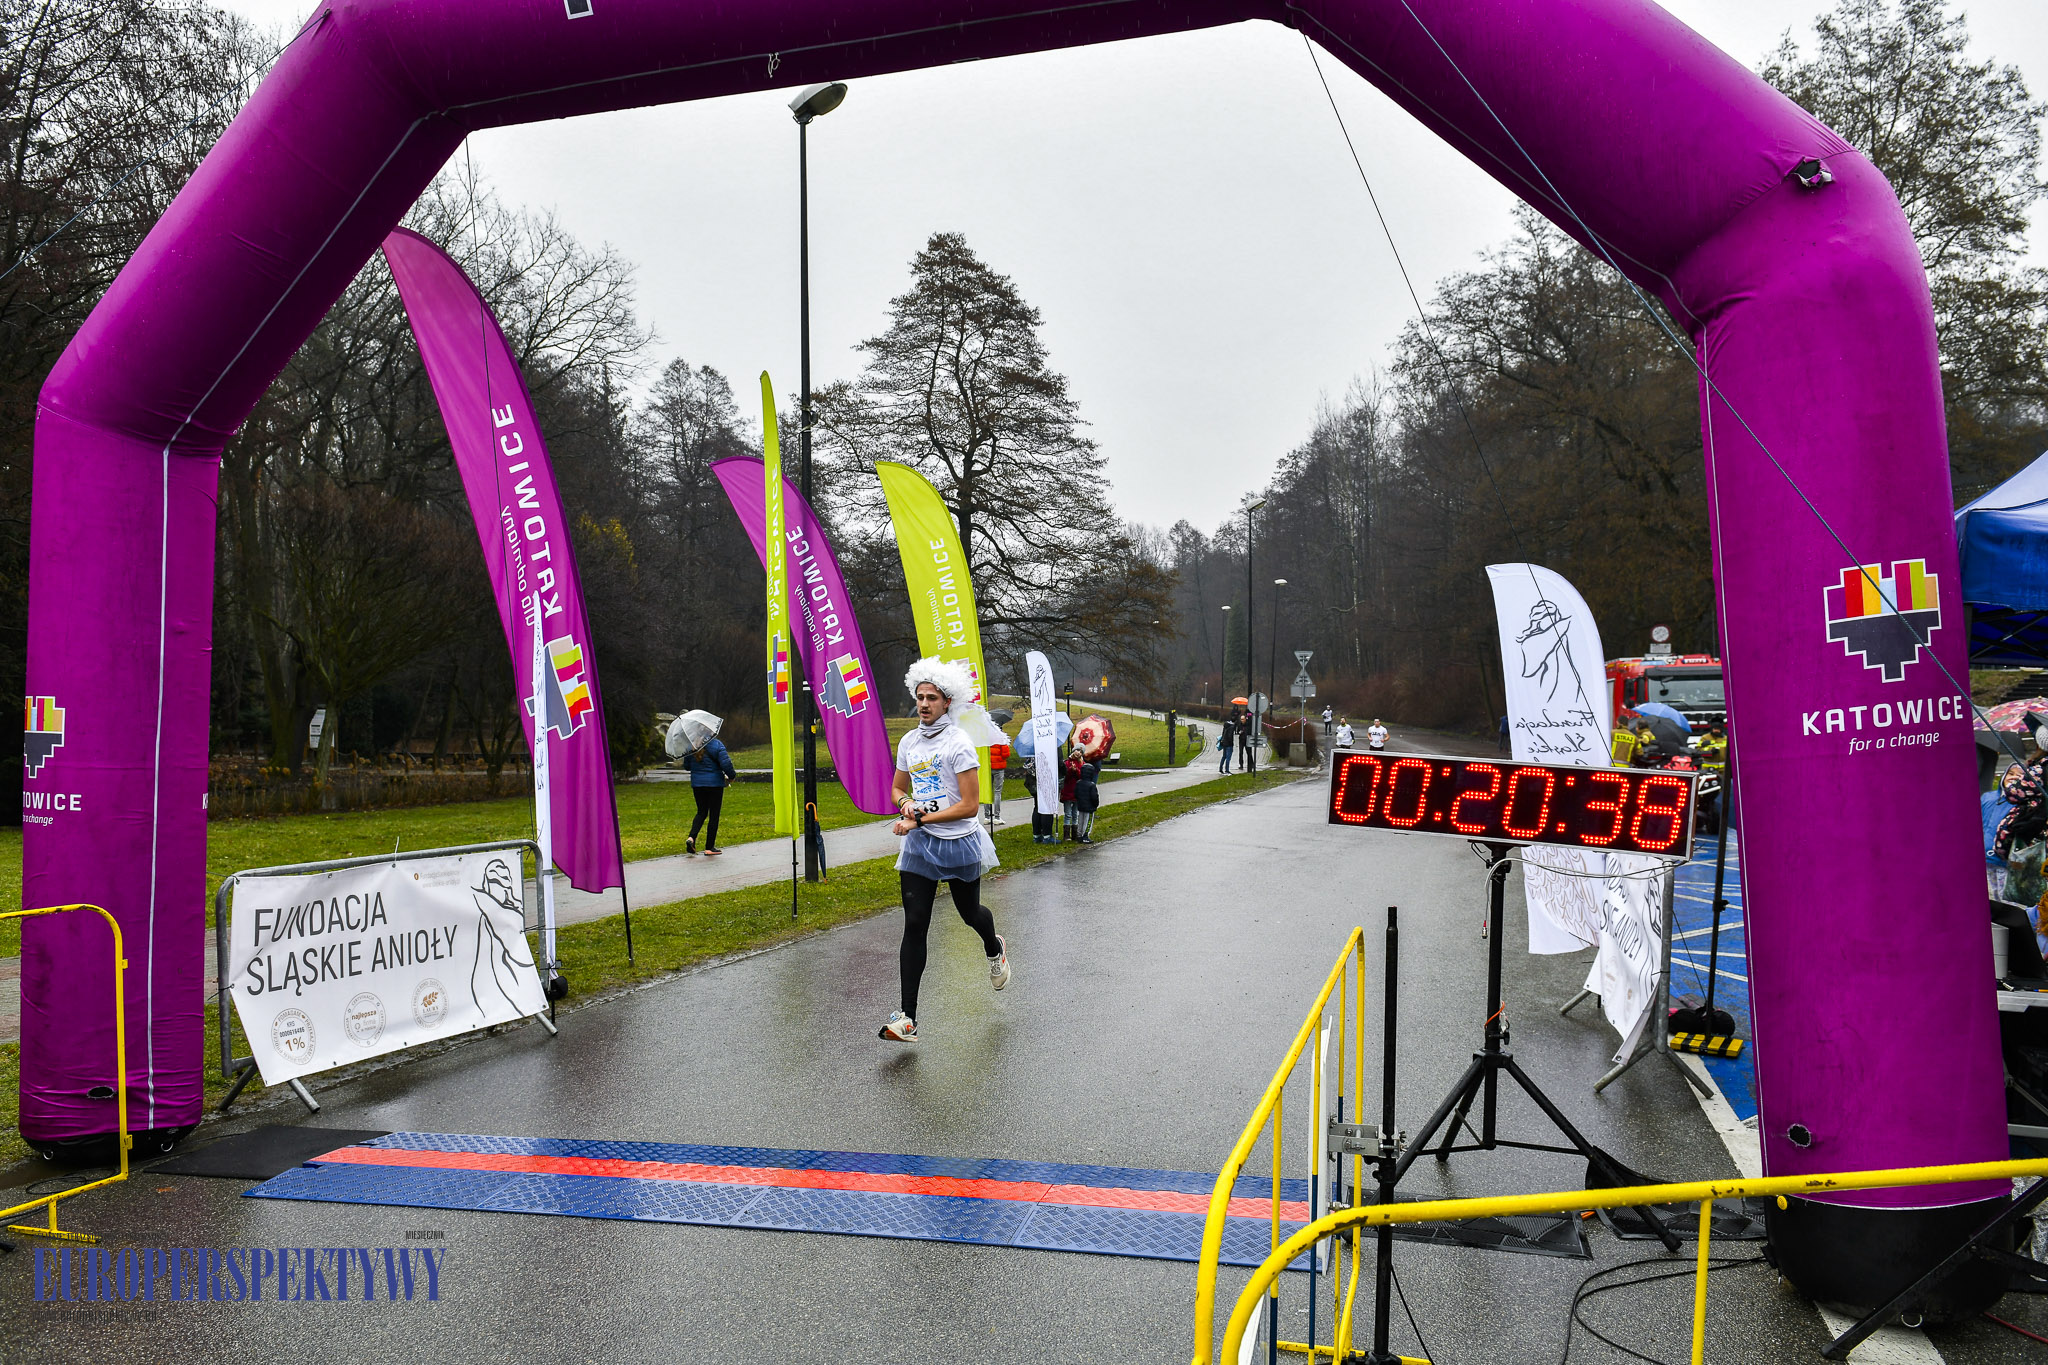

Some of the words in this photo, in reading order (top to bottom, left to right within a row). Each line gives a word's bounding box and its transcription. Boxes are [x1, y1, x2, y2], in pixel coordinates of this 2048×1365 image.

[1802, 695, 1964, 736] KATOWICE
[1848, 737, 1872, 756] for
[1876, 738, 1885, 749] a
[1890, 732, 1940, 747] change
[1334, 755, 1689, 850] 00:20:38
[254, 891, 388, 947] FUNDACJA
[246, 940, 362, 997] ŚLĄSKIE
[371, 924, 458, 973] ANIOŁY
[285, 1036, 306, 1052] 1%
